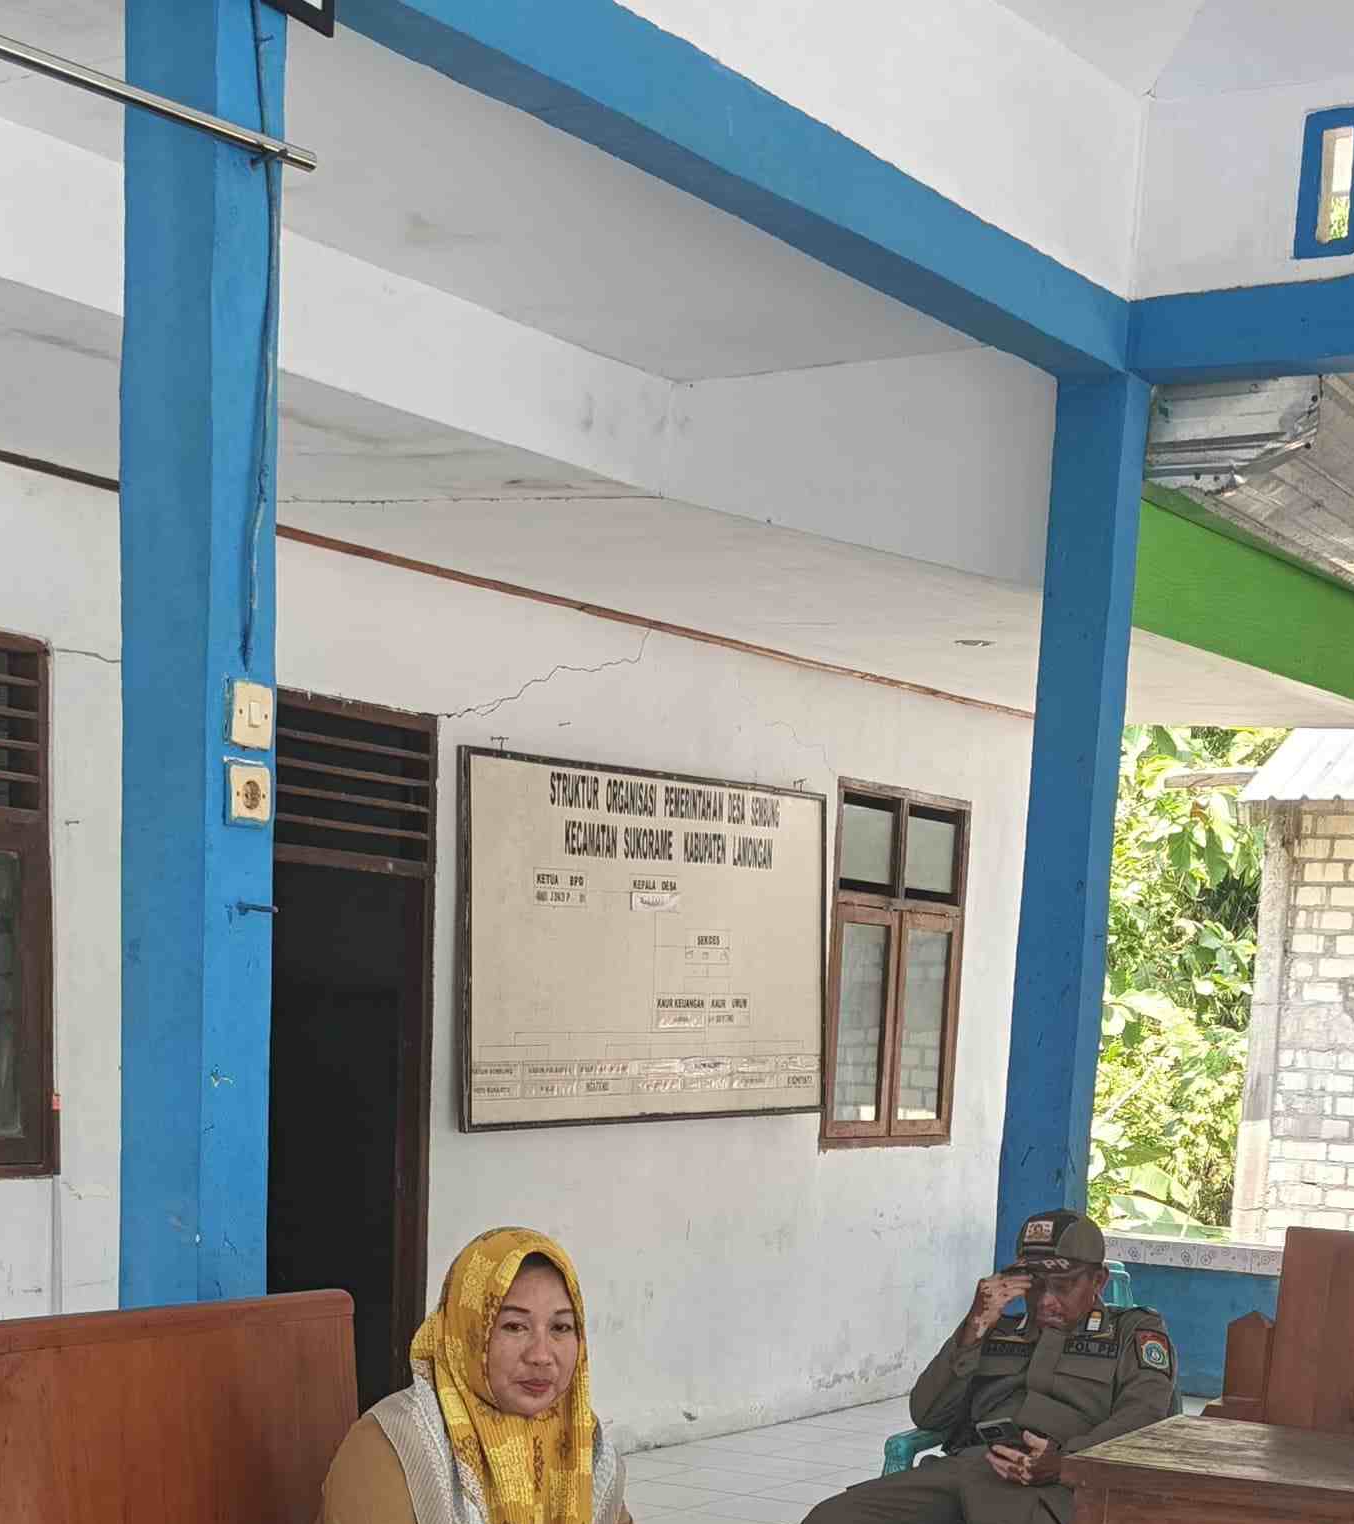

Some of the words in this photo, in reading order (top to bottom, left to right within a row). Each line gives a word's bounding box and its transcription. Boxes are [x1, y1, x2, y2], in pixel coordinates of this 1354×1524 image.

[549, 772, 599, 810] STRUKTUR
[606, 778, 657, 817] ORGANISASI
[663, 784, 724, 822] PEMERINTAHAN
[727, 792, 745, 825] DESA
[751, 796, 780, 829] SEMBUNG
[564, 820, 617, 859] KECAMATAN
[624, 827, 673, 861] SUKORAME
[683, 832, 726, 865] KABUPATEN
[733, 836, 773, 870] LAMONGAN
[536, 874, 559, 885] KETUA
[633, 879, 656, 890] KEPALA
[661, 881, 677, 891] DESA
